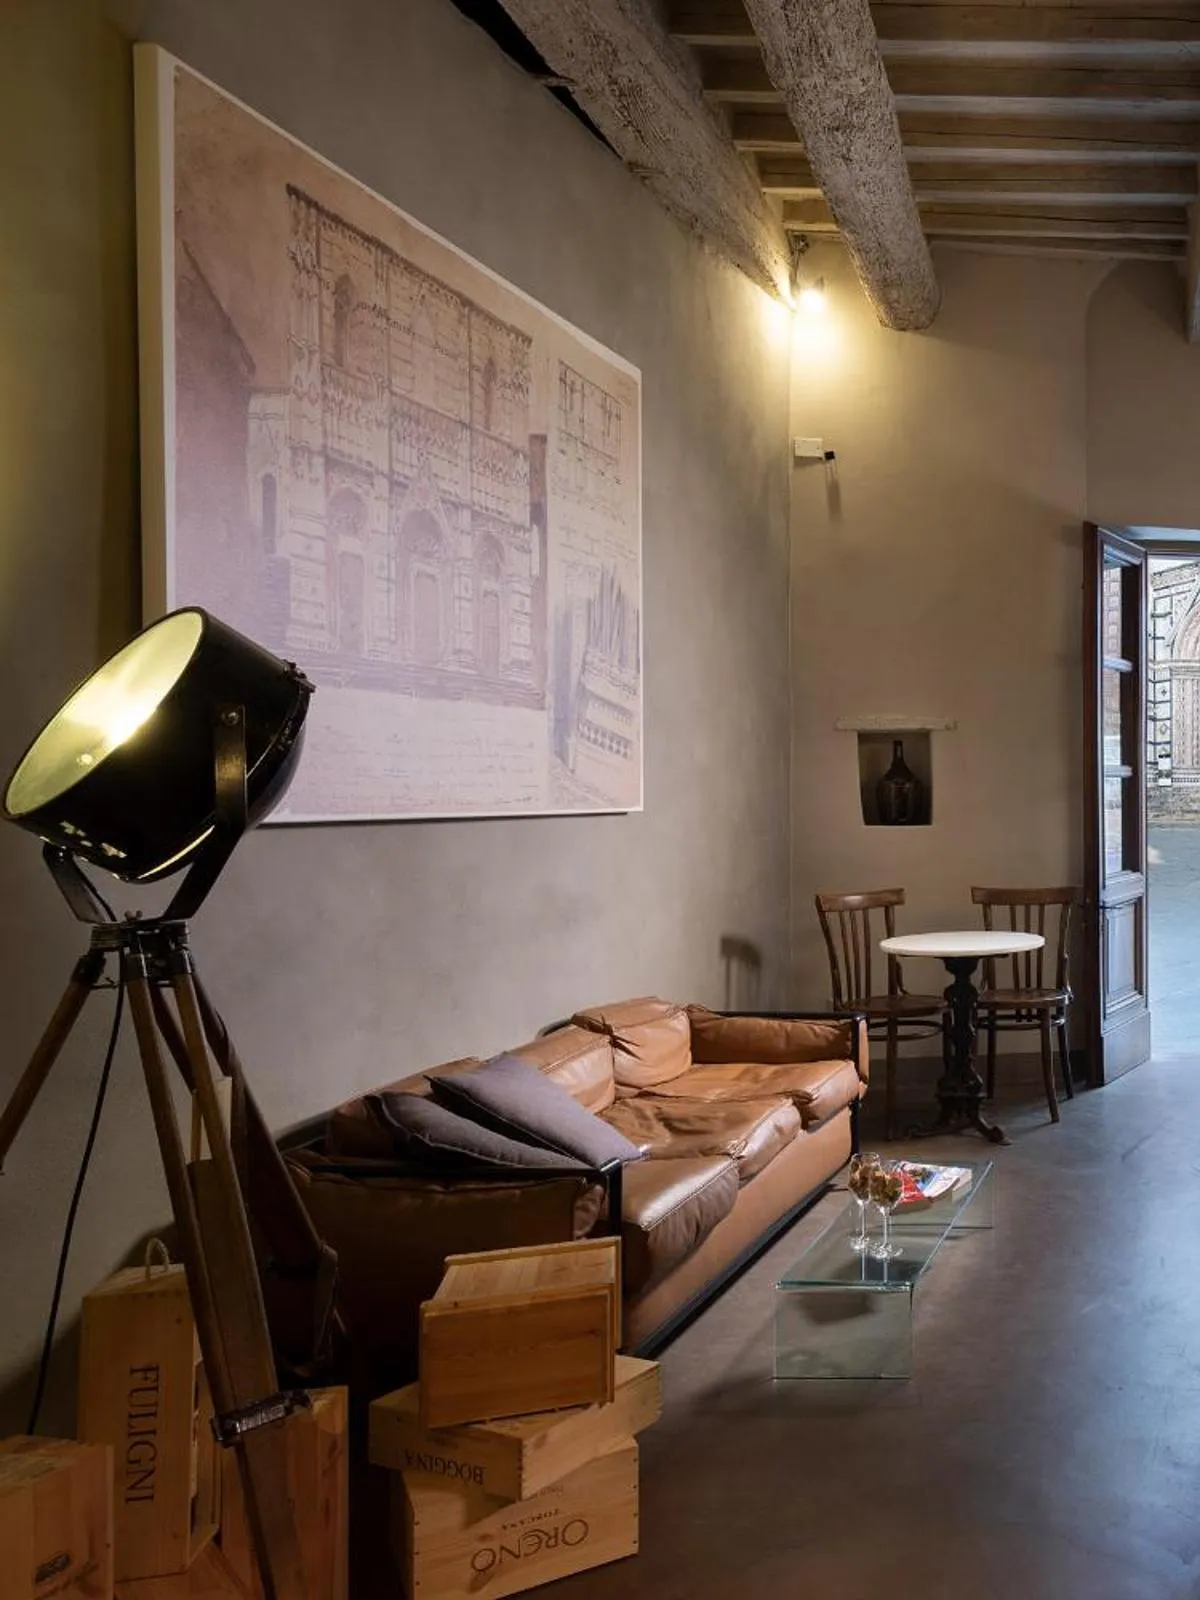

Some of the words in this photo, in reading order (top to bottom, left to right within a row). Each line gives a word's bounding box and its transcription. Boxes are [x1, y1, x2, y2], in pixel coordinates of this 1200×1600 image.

[124, 1363, 160, 1505] FULIGNI
[404, 1450, 487, 1486] BOGGINA
[470, 1518, 590, 1573] ORENO
